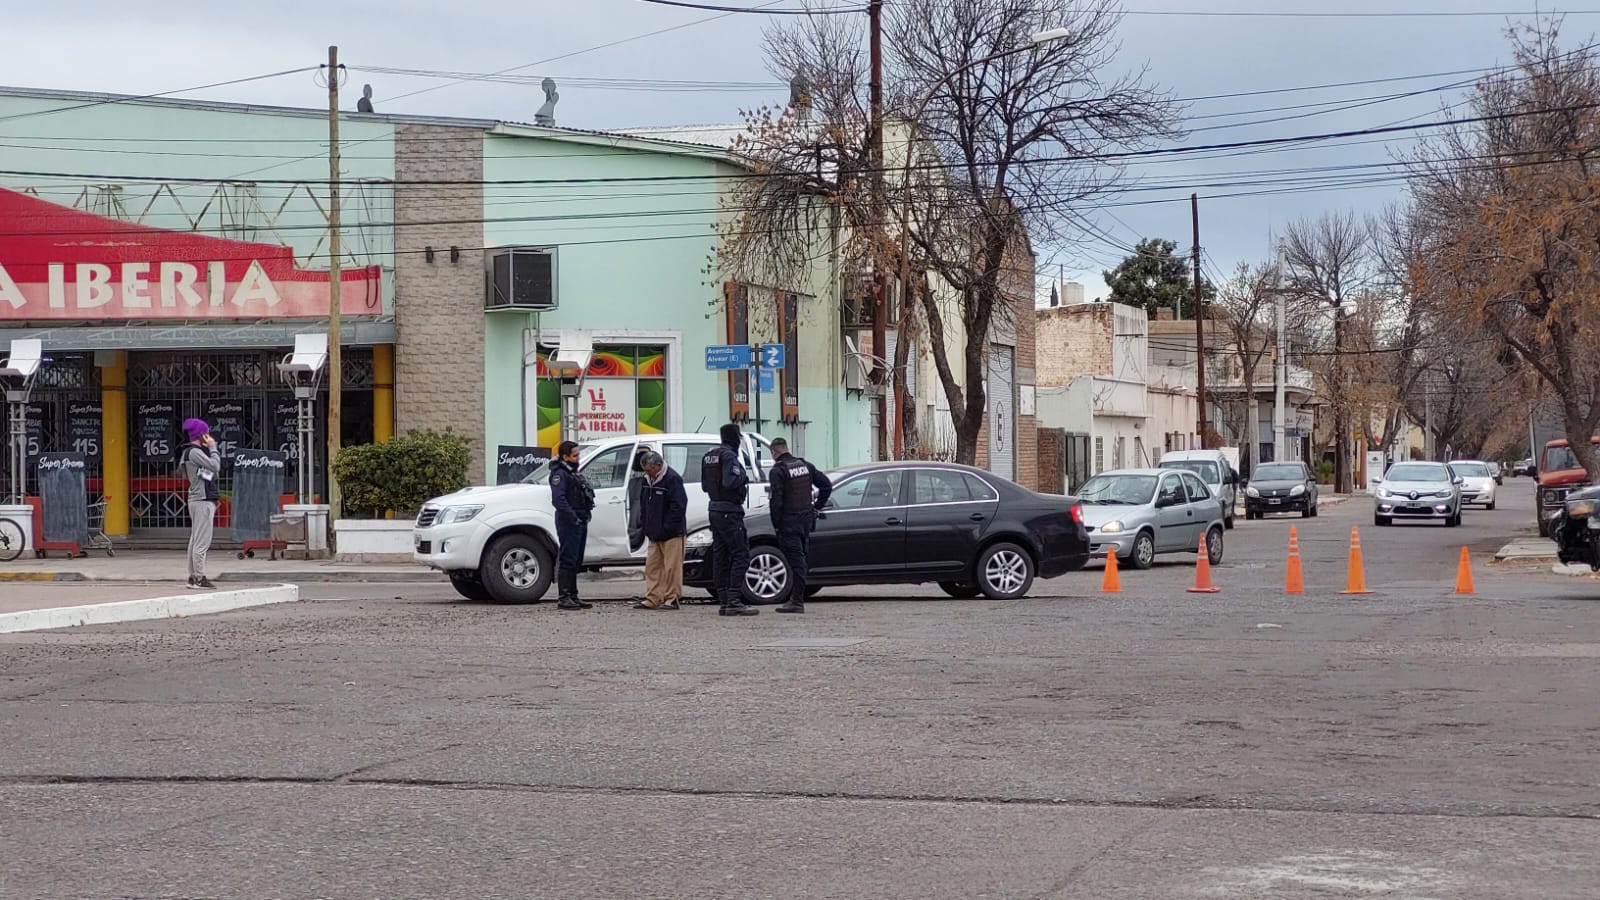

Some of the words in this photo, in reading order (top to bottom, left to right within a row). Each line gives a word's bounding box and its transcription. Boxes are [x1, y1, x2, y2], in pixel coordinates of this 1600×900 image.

[48, 259, 281, 309] IBERIA
[139, 405, 157, 415] Super
[578, 421, 587, 431] A
[590, 421, 627, 432] IBERIA
[72, 438, 98, 456] 115
[143, 440, 169, 456] 165
[38, 456, 61, 470] Super
[234, 454, 259, 468] Super
[499, 452, 524, 466] Super
